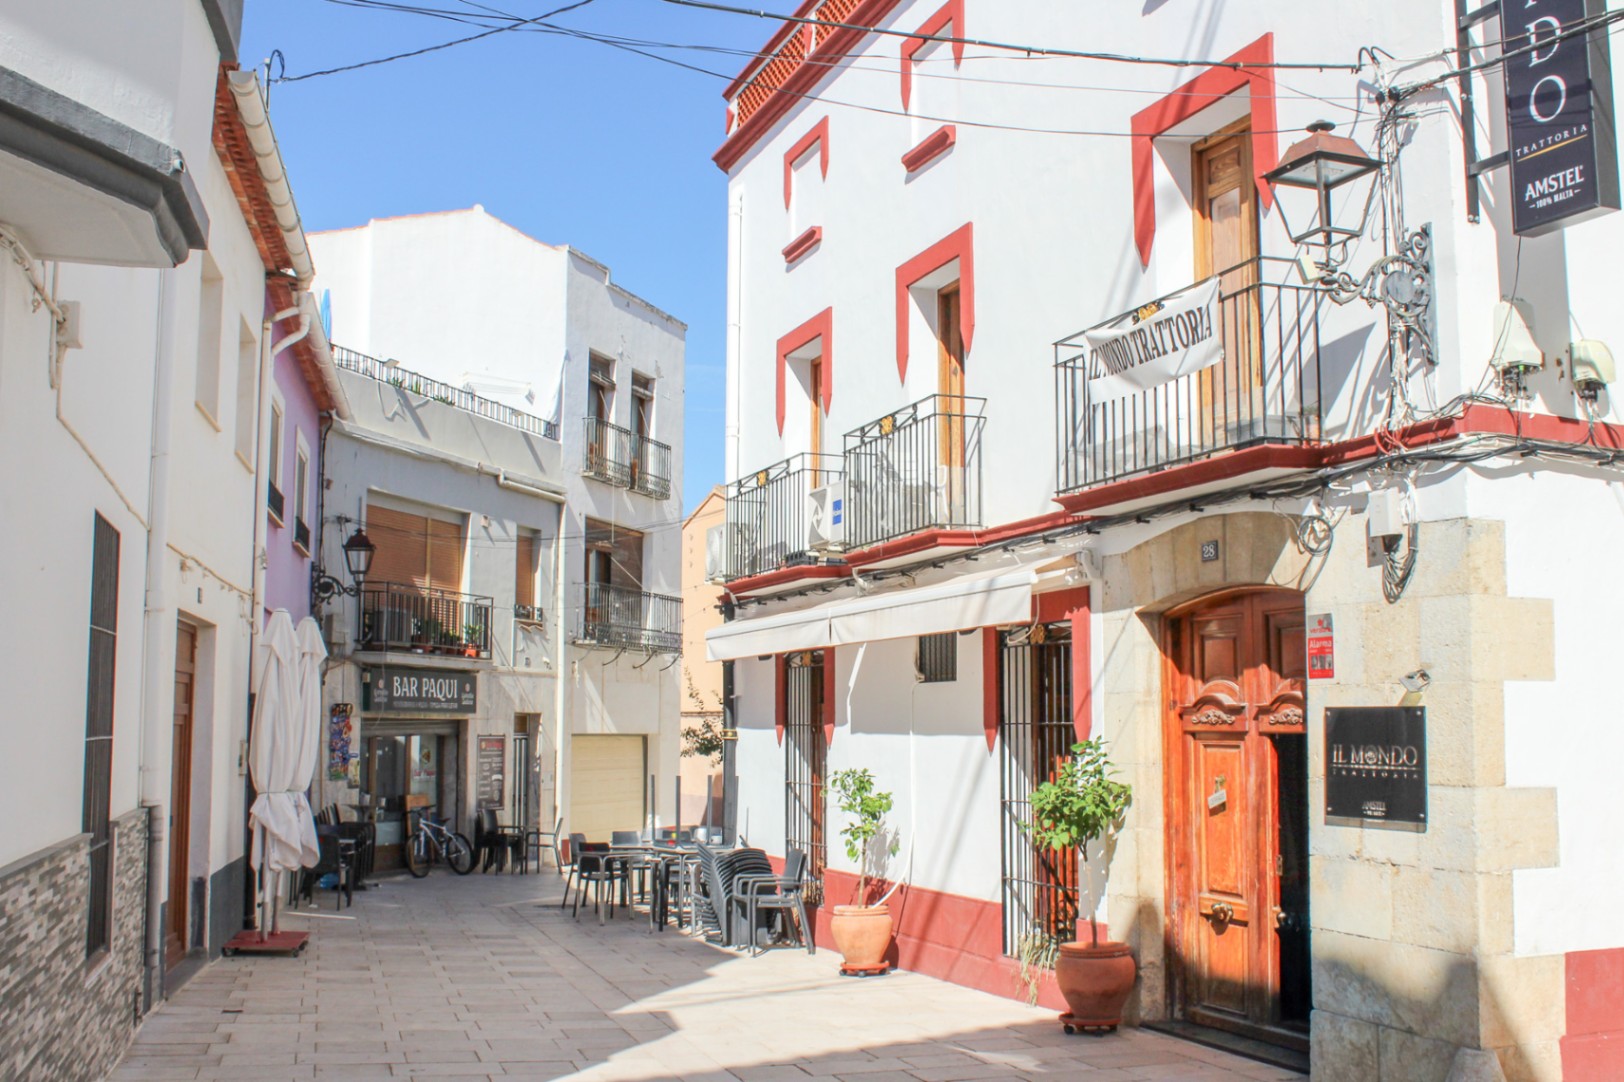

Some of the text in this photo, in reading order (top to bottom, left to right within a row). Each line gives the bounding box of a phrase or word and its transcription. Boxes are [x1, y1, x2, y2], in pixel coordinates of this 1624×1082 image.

[1524, 0, 1566, 122] DO
[1516, 124, 1587, 157] TRATTORIA
[1525, 166, 1584, 201] AMSTEL
[1554, 189, 1573, 203] MALTA
[1130, 303, 1213, 365] TRATTORIA
[1203, 544, 1214, 557] 28
[393, 676, 458, 701] BAR PAQUI
[1333, 744, 1418, 766] IL MONDO
